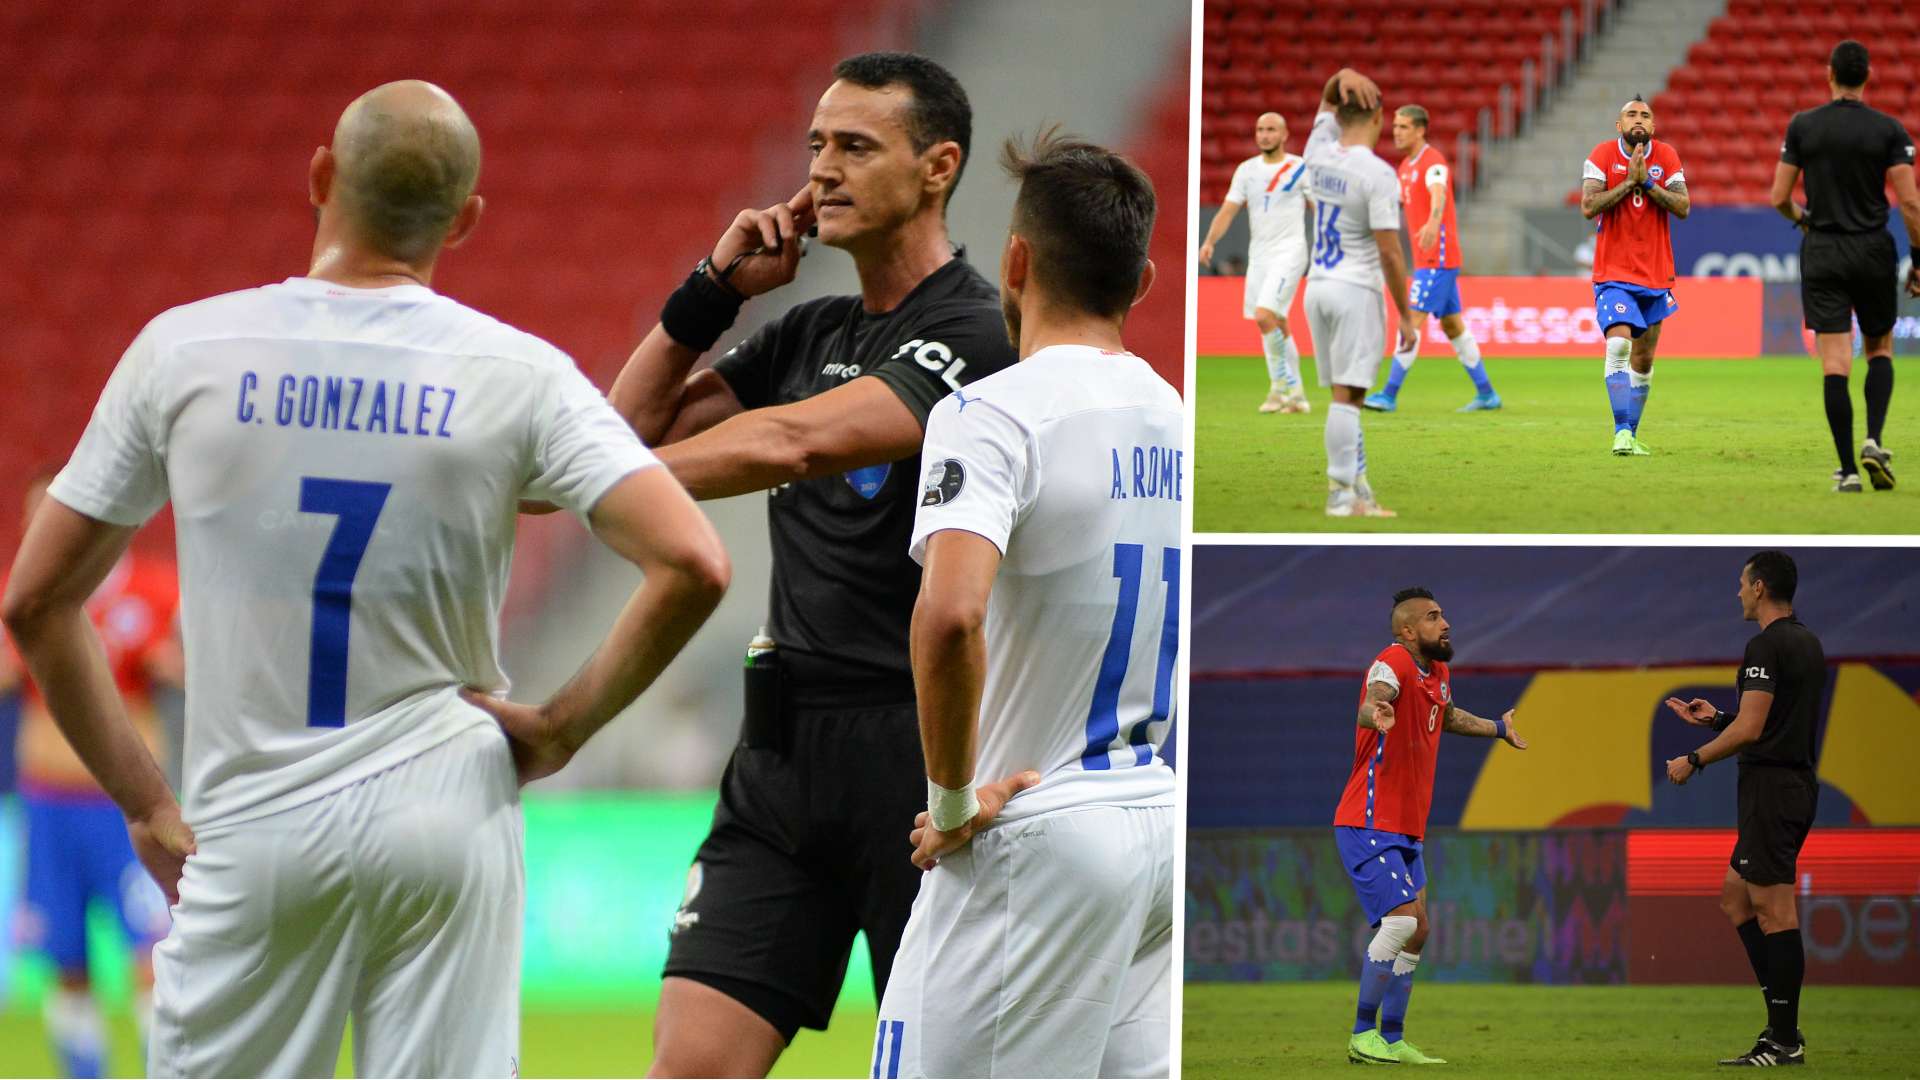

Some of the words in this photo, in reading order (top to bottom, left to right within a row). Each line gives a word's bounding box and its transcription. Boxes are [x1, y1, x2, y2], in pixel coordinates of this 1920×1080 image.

[1633, 187, 1643, 208] 8
[1315, 199, 1345, 269] 16
[891, 339, 967, 392] TCL
[236, 370, 263, 424] C.
[275, 373, 456, 438] GONZALEZ
[1110, 447, 1127, 500] A.
[297, 476, 392, 728] 7
[1080, 543, 1181, 770] 11
[1428, 704, 1439, 732] 8
[1190, 908, 1338, 961] estas
[873, 1020, 905, 1079] 11
